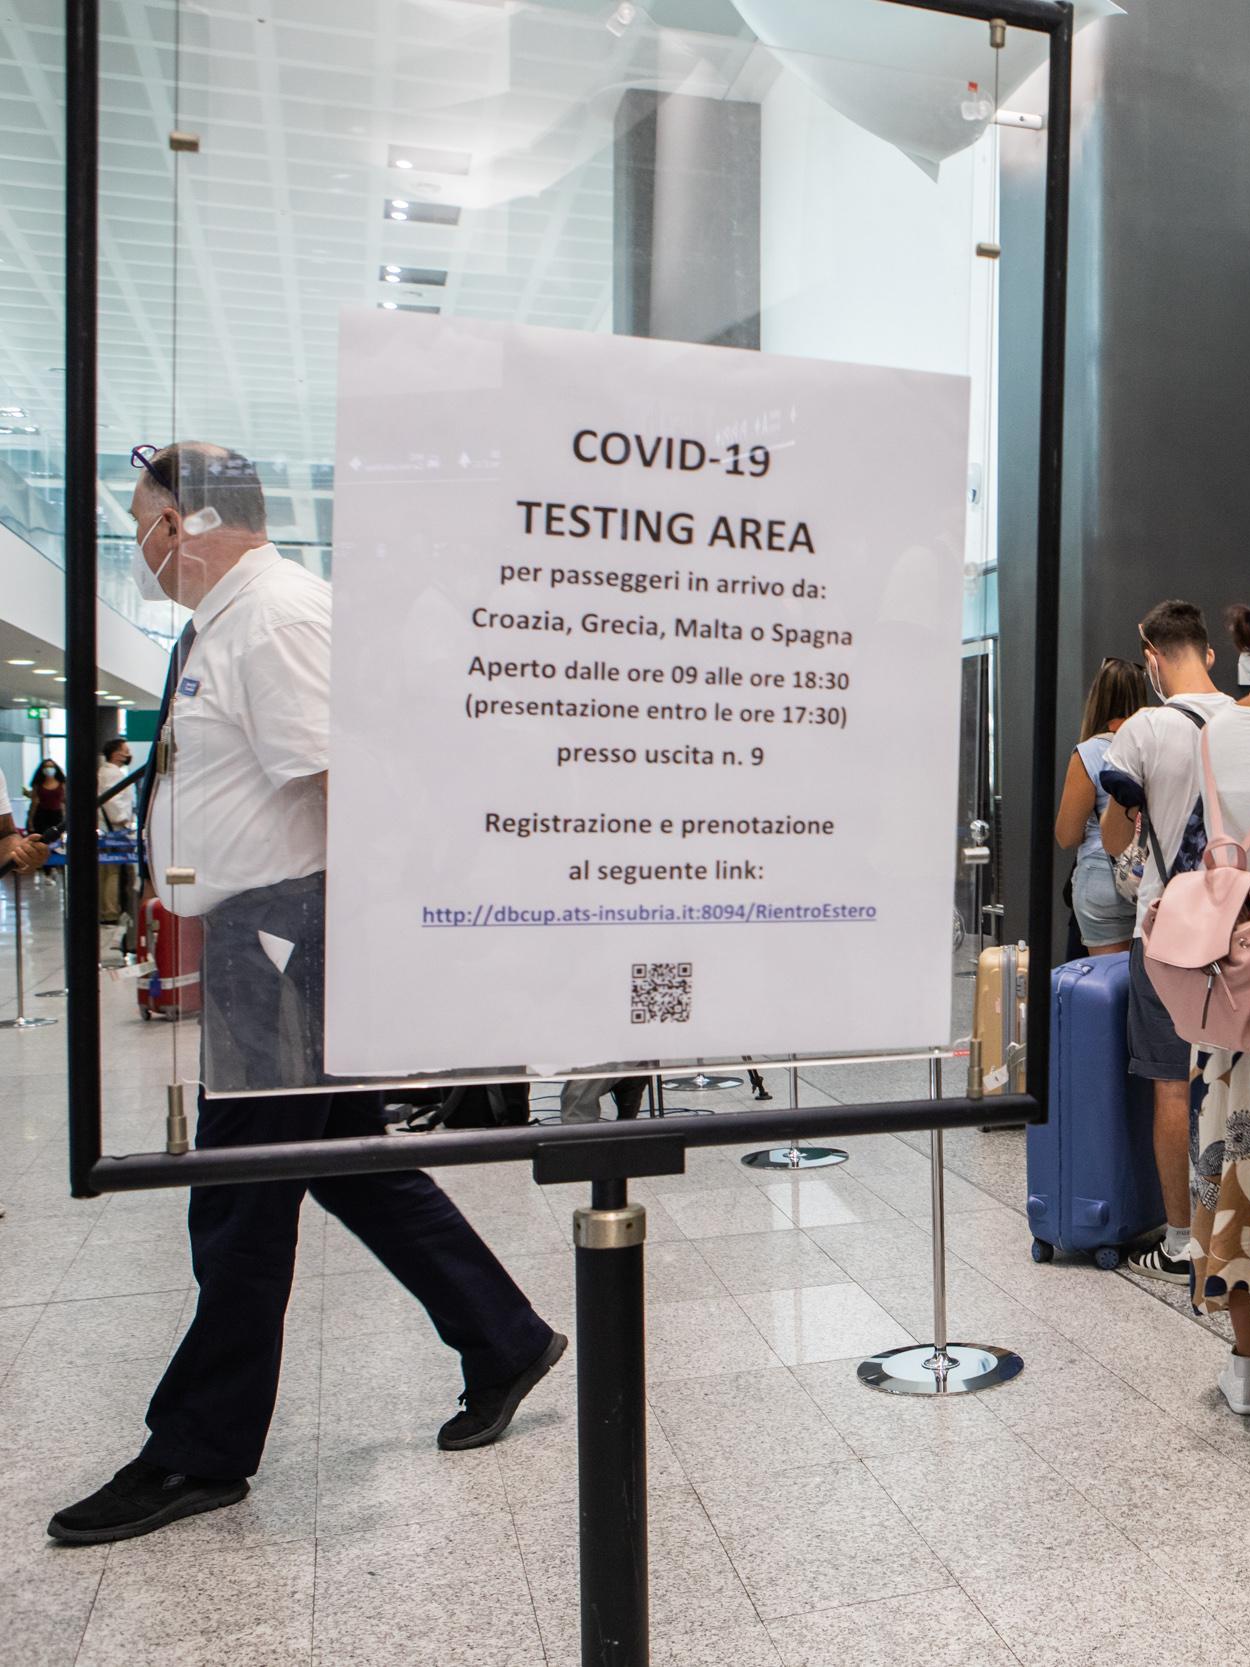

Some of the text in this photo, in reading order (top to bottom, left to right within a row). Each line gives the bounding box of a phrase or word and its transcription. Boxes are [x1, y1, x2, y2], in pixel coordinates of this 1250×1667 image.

[572, 428, 771, 478] COVID-19
[515, 499, 816, 555] TESTING AREA
[501, 565, 827, 600] per passeggeri in arrivo da:
[471, 606, 853, 650] Croazia, Grecia, Malta o Spagna
[467, 655, 850, 691] Aperto dalle ore 09 alle ore 18:30
[465, 693, 847, 730] (presentazione entro le ore 17:30)
[556, 744, 765, 768] presso uscita n. 9
[485, 812, 835, 839] Registrazione e prenotazione
[568, 859, 764, 886] al seguente link:
[422, 902, 877, 928] http://dbcup.ats-insubria.it:8094/RientroEstero
